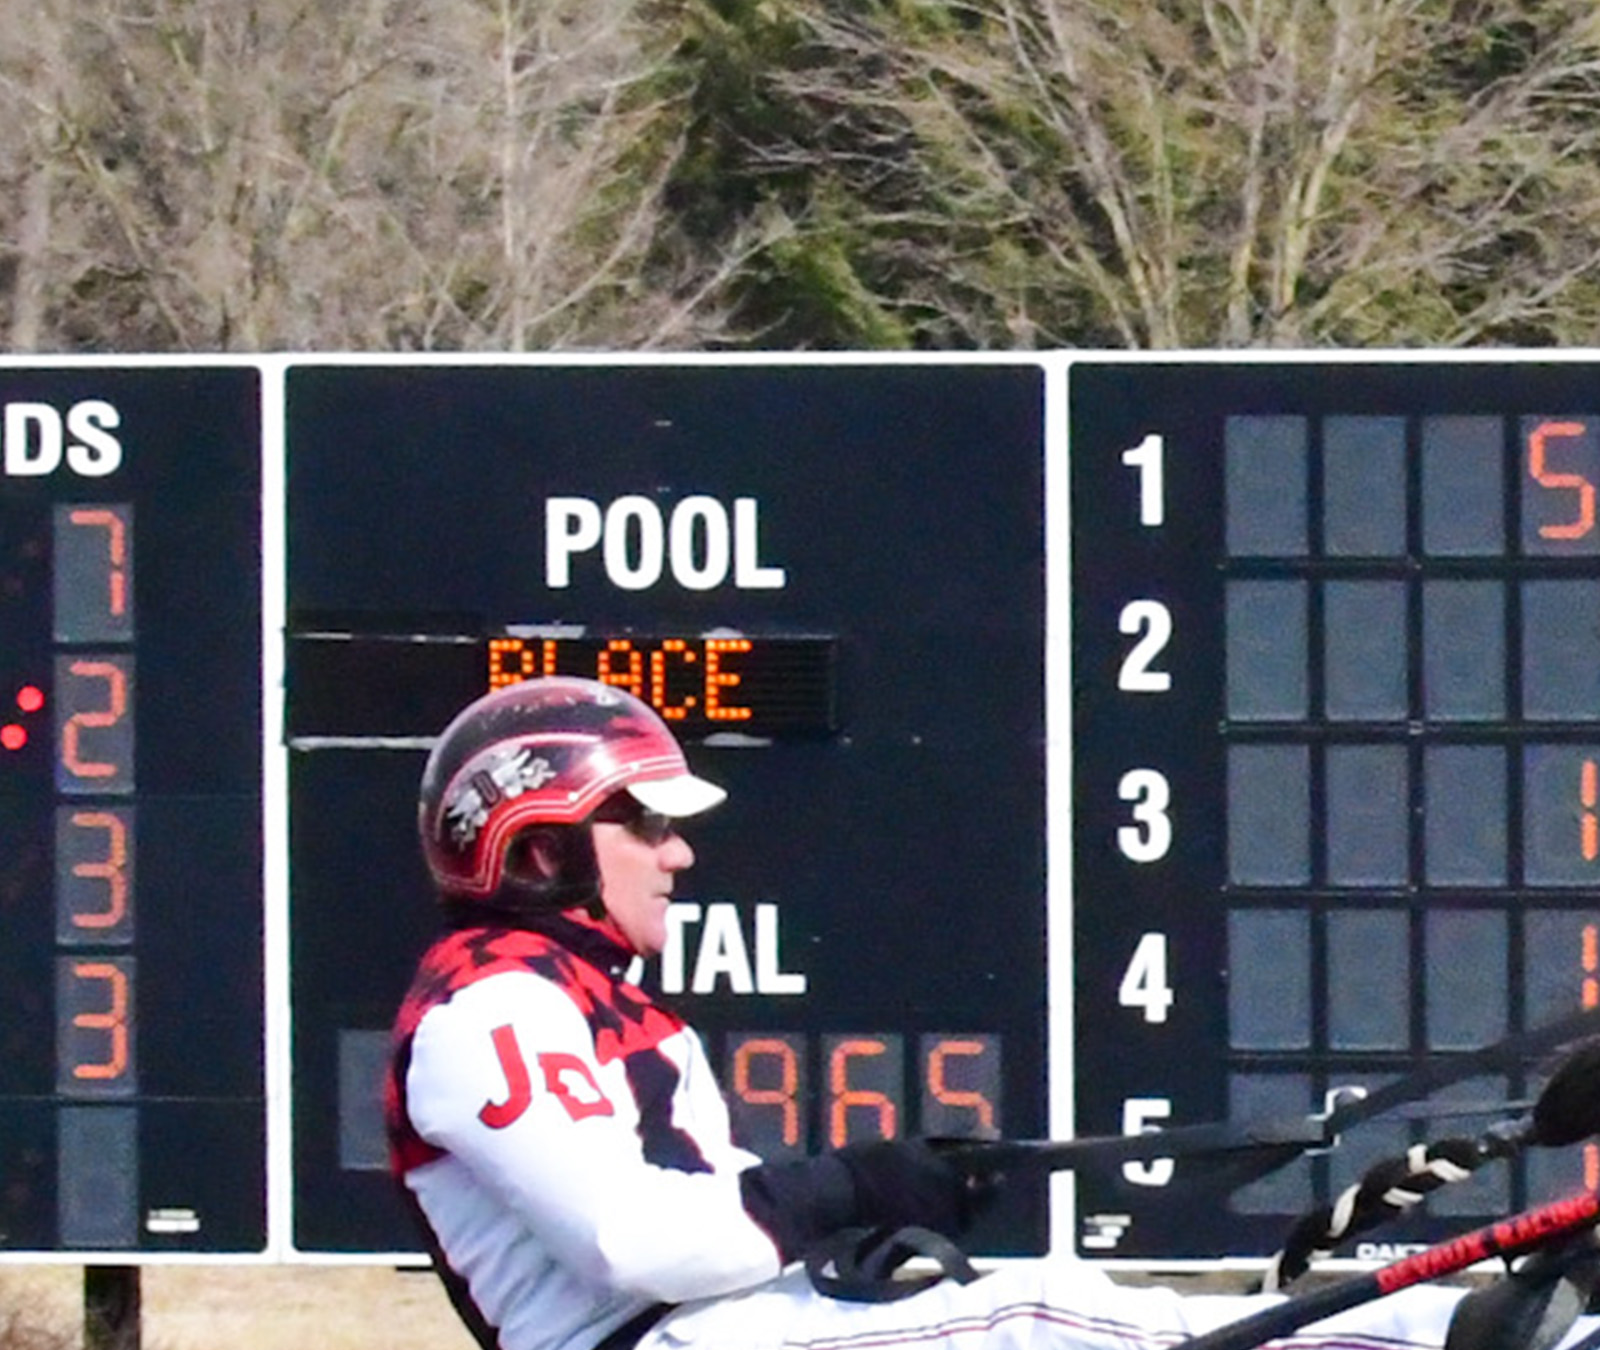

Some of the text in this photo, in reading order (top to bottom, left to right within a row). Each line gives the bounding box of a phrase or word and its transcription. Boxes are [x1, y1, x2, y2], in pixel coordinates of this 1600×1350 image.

[1122, 434, 1164, 526] 1
[73, 510, 126, 616] 7
[545, 495, 786, 590] POOL
[1118, 600, 1172, 691] 2
[63, 661, 126, 778] 2
[1118, 769, 1172, 863] 3
[73, 813, 126, 928] 3
[73, 963, 127, 1080] 3
[1119, 933, 1174, 1023] 4
[734, 1038, 994, 1149] 965
[1122, 1098, 1175, 1186] 5
